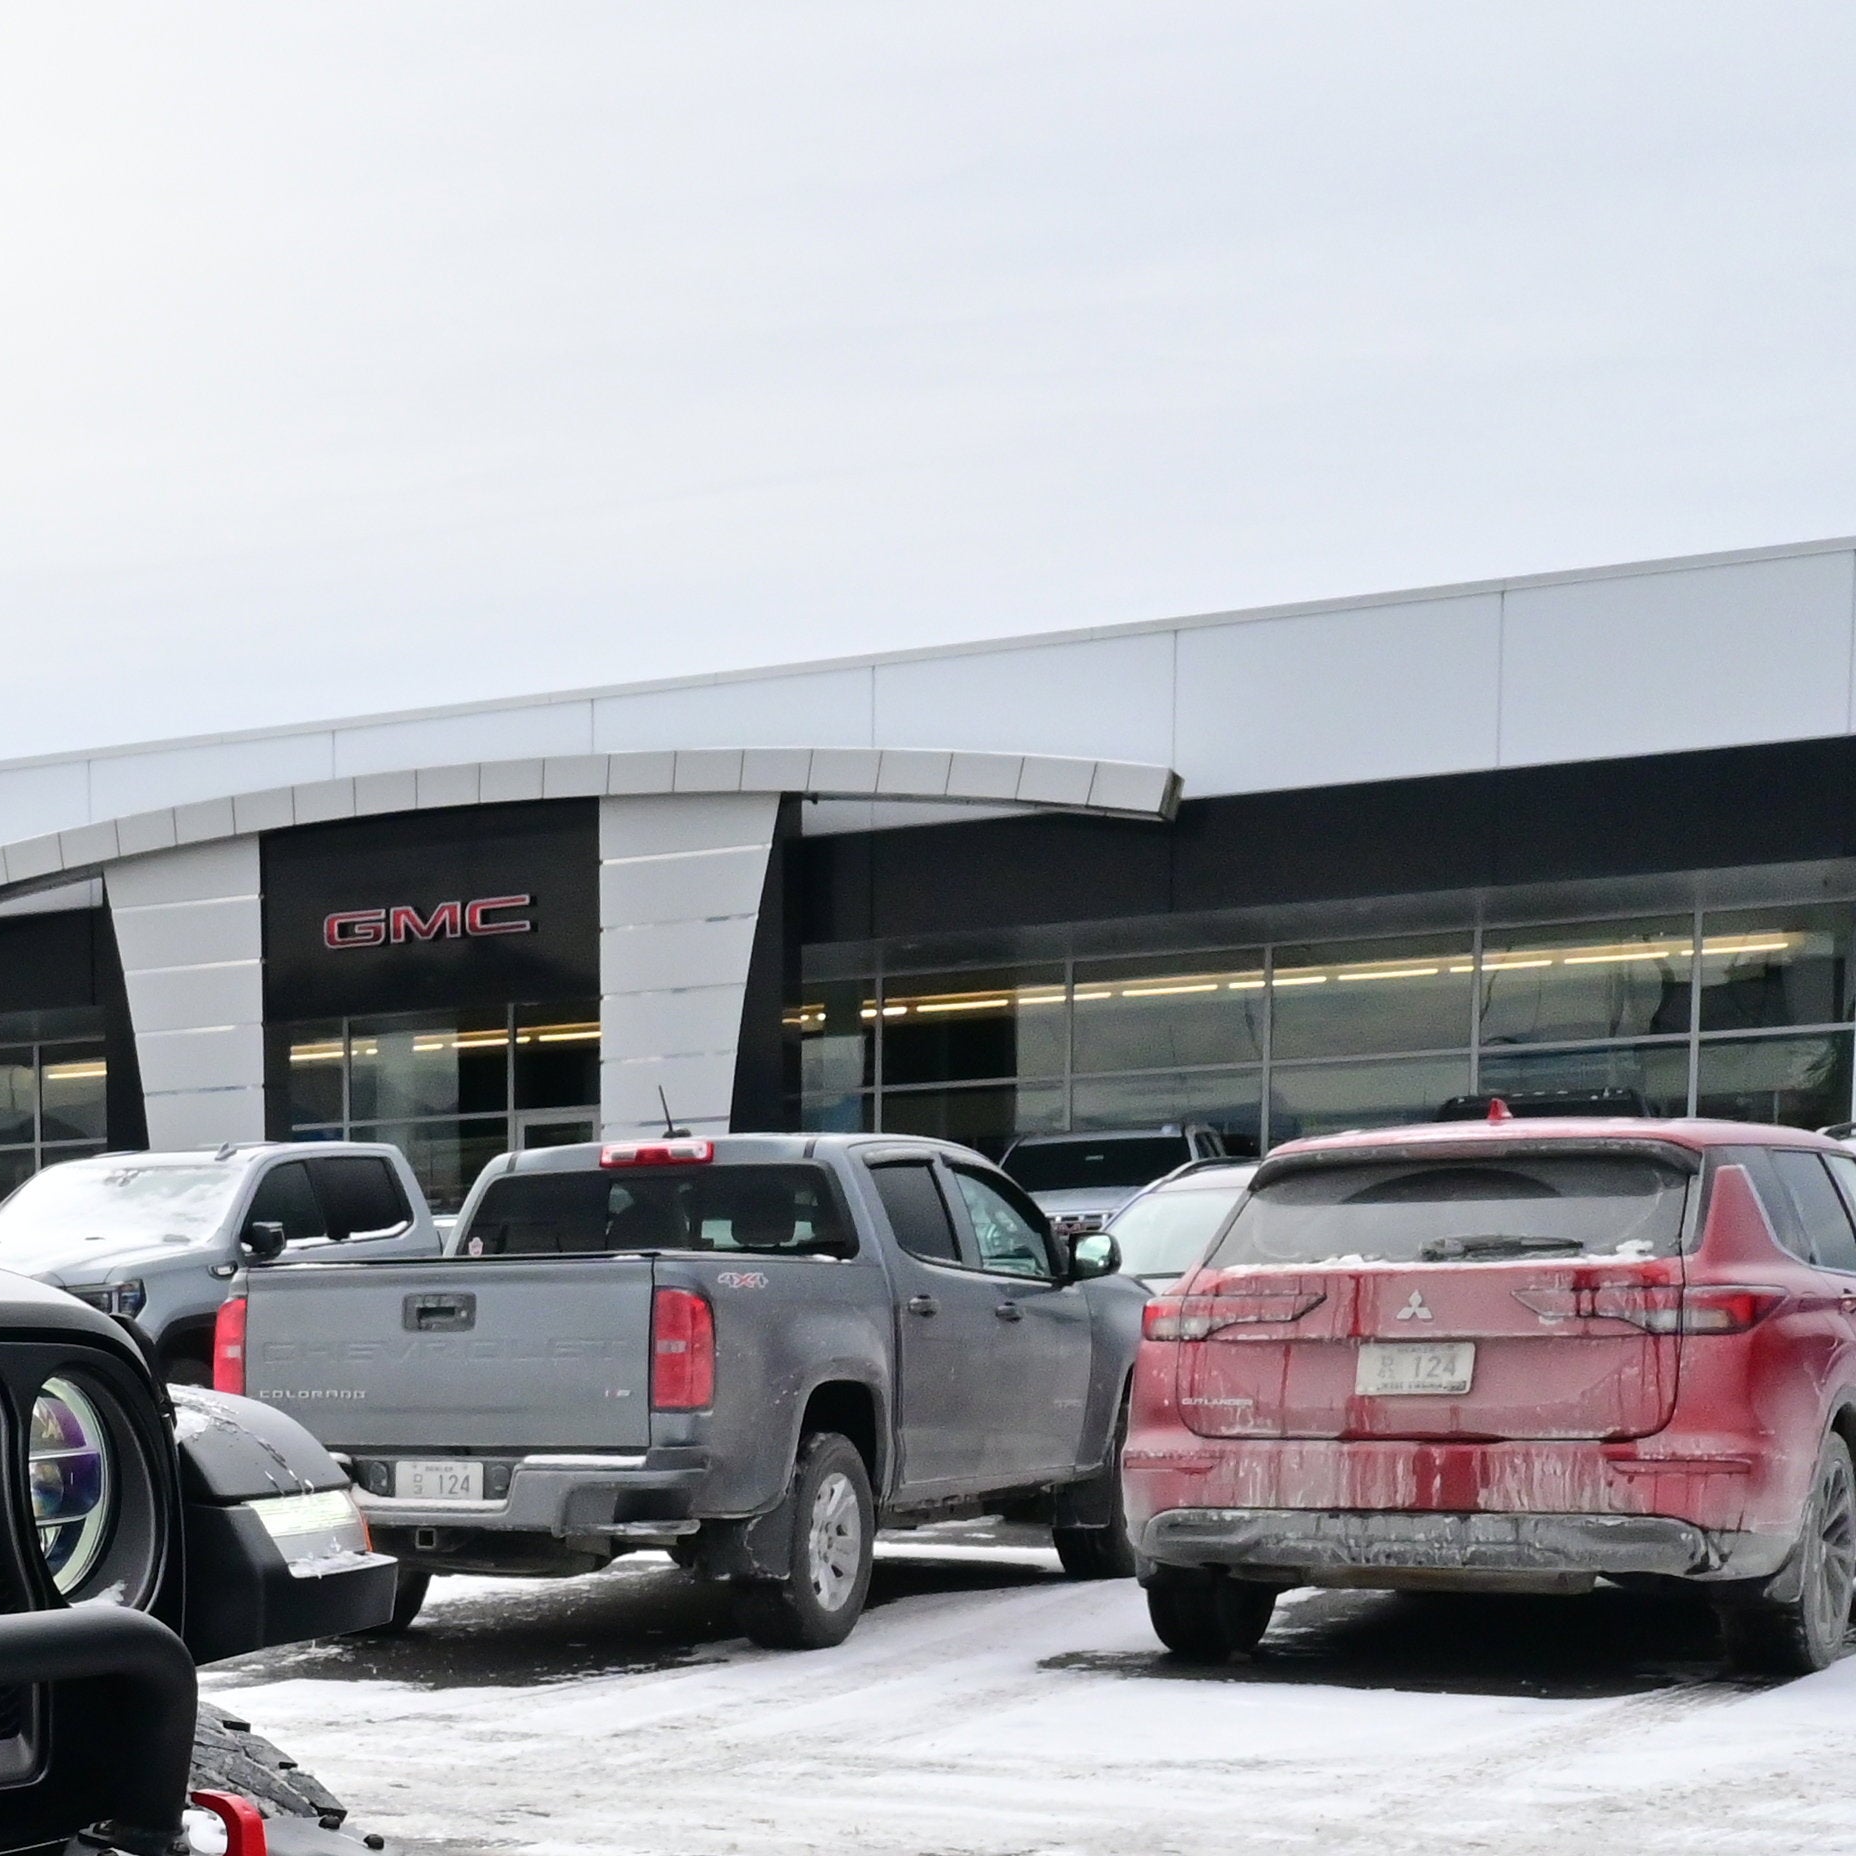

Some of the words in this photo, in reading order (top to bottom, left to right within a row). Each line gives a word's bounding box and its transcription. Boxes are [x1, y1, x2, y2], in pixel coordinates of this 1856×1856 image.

[324, 894, 531, 949] GMC
[259, 1389, 366, 1399] COLORADO
[438, 1473, 471, 1495] 124
